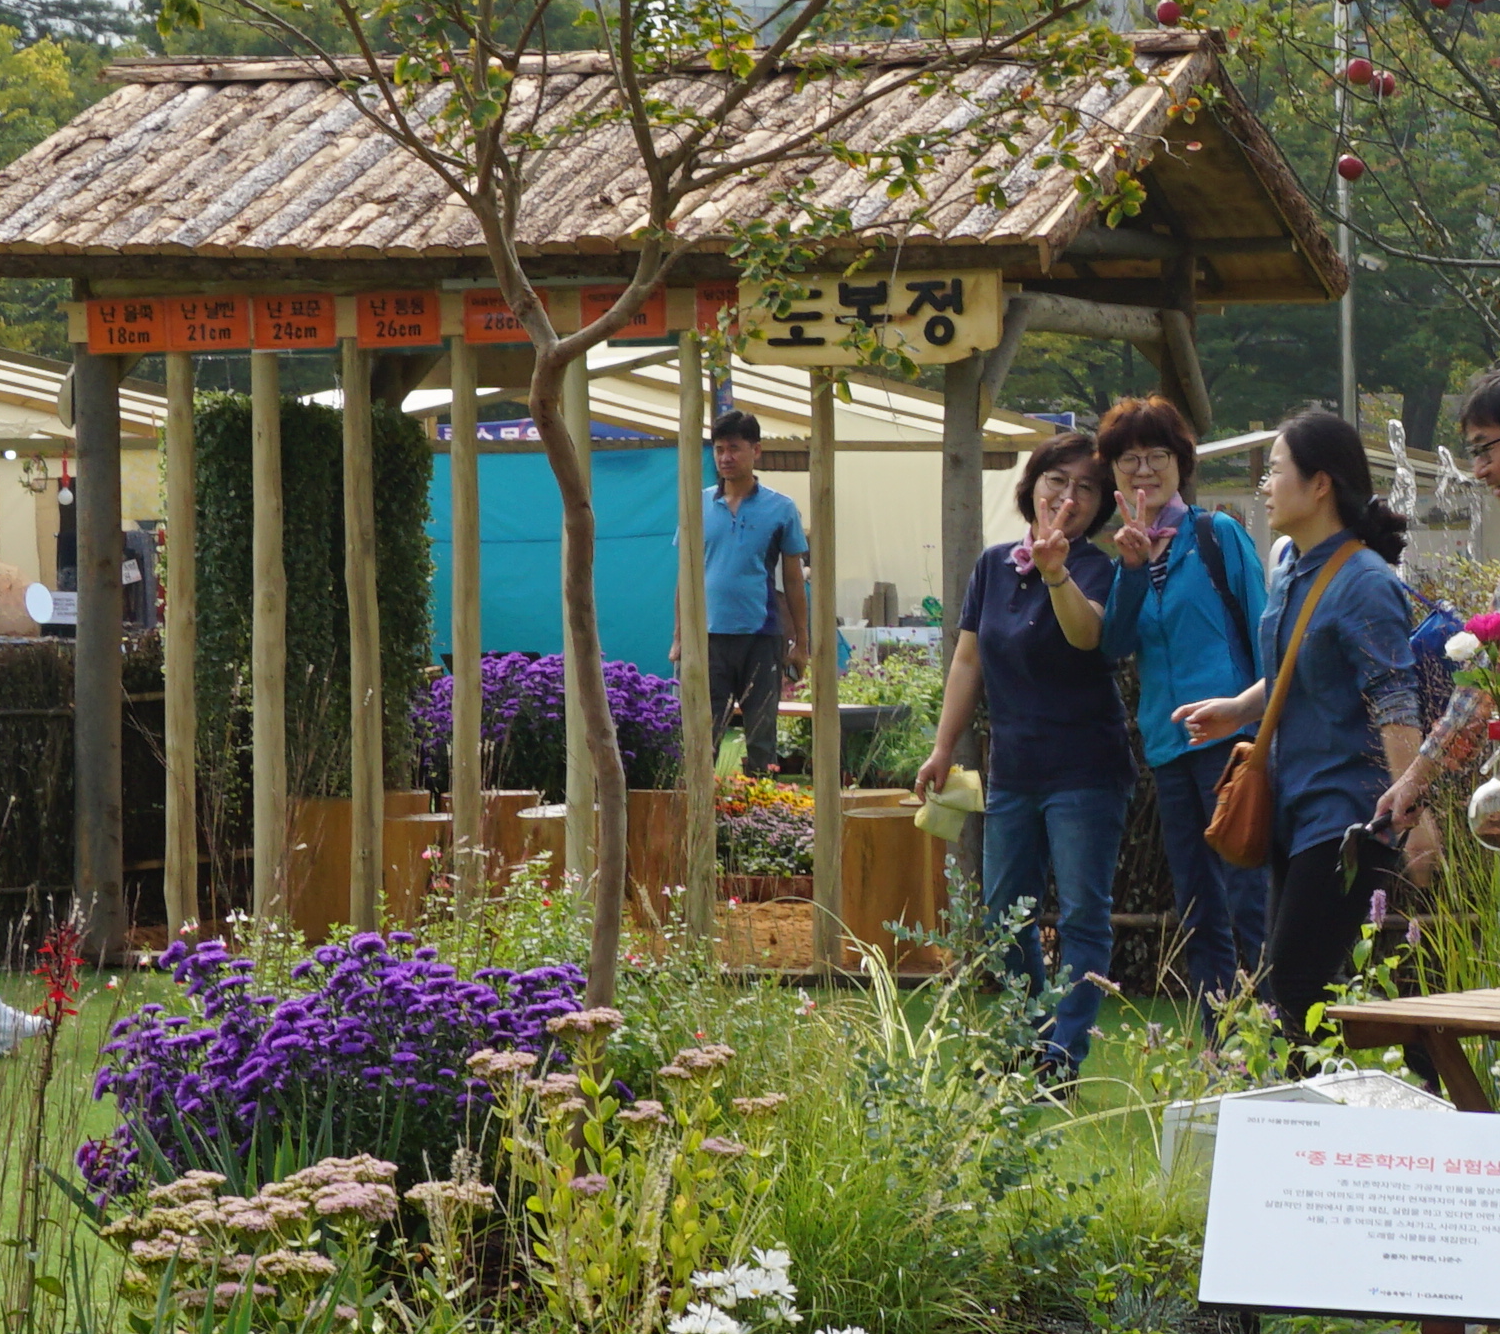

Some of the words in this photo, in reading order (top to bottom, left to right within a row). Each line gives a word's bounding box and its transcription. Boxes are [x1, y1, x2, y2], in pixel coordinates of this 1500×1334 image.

[101, 306, 116, 323] 난
[181, 302, 197, 320] 난
[204, 301, 235, 319] 날씬
[267, 301, 282, 318] 난
[290, 300, 321, 317] 표준
[370, 298, 386, 316] 난
[107, 327, 151, 345] 18cm
[187, 324, 232, 341] 21cm
[273, 322, 317, 340] 24cm
[376, 320, 421, 338] 26cm
[1333, 1152, 1435, 1172] 보존학자의
